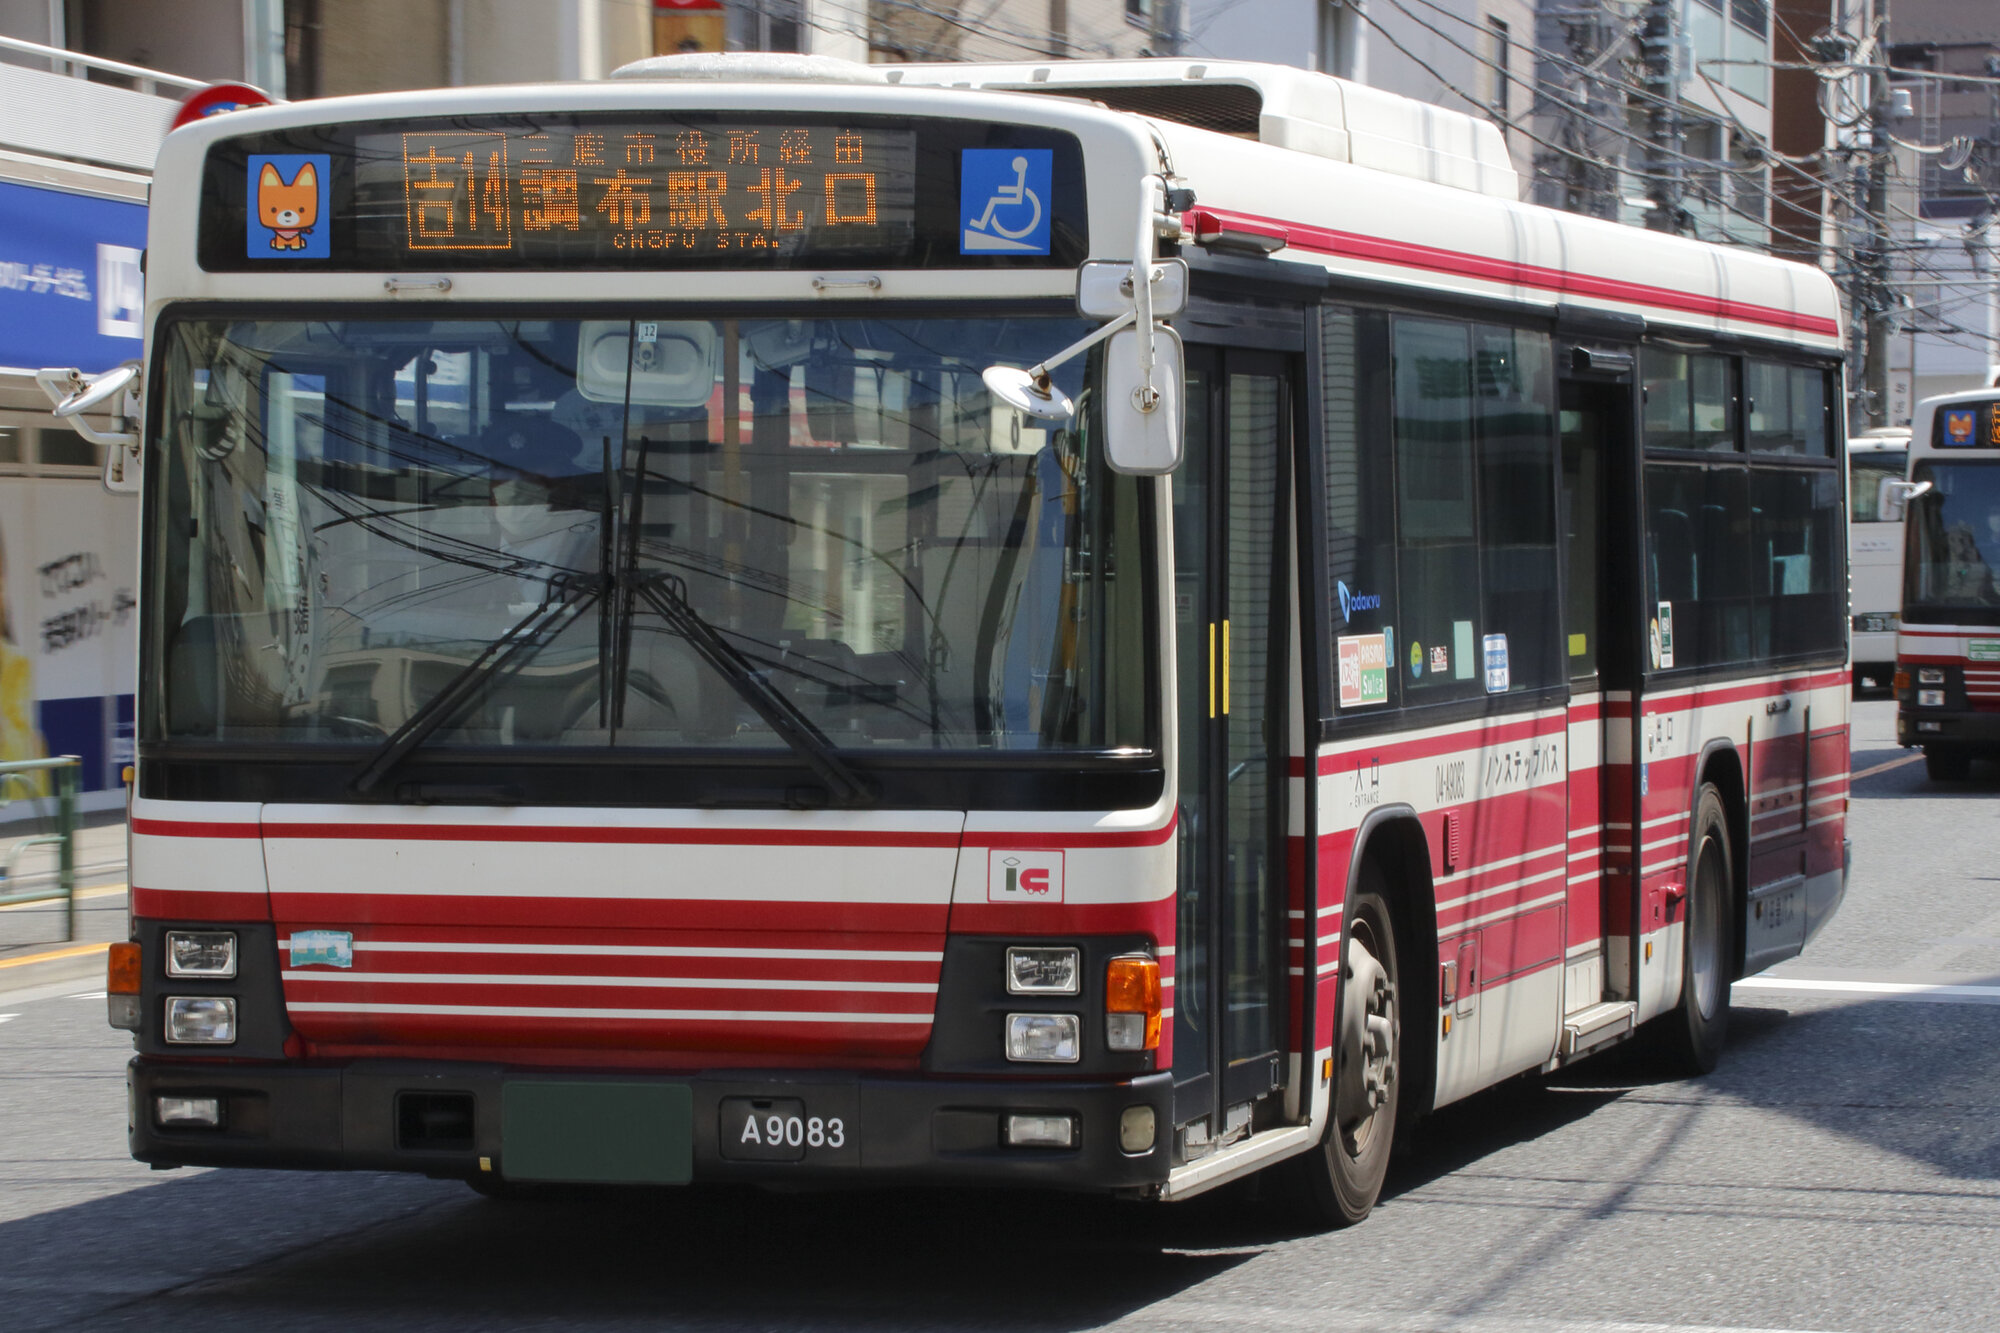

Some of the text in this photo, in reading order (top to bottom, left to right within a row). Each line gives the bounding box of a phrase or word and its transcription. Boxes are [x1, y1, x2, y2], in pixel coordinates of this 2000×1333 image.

[521, 129, 864, 165] 三鷹市役所経由
[519, 167, 877, 231] 調布駅北口
[717, 232, 779, 249] STA.
[644, 325, 656, 337] 12
[1350, 590, 1381, 611] odakyu
[1363, 673, 1384, 696] Suica
[1484, 744, 1560, 788] ノンステップバス
[740, 1114, 845, 1148] A9083
